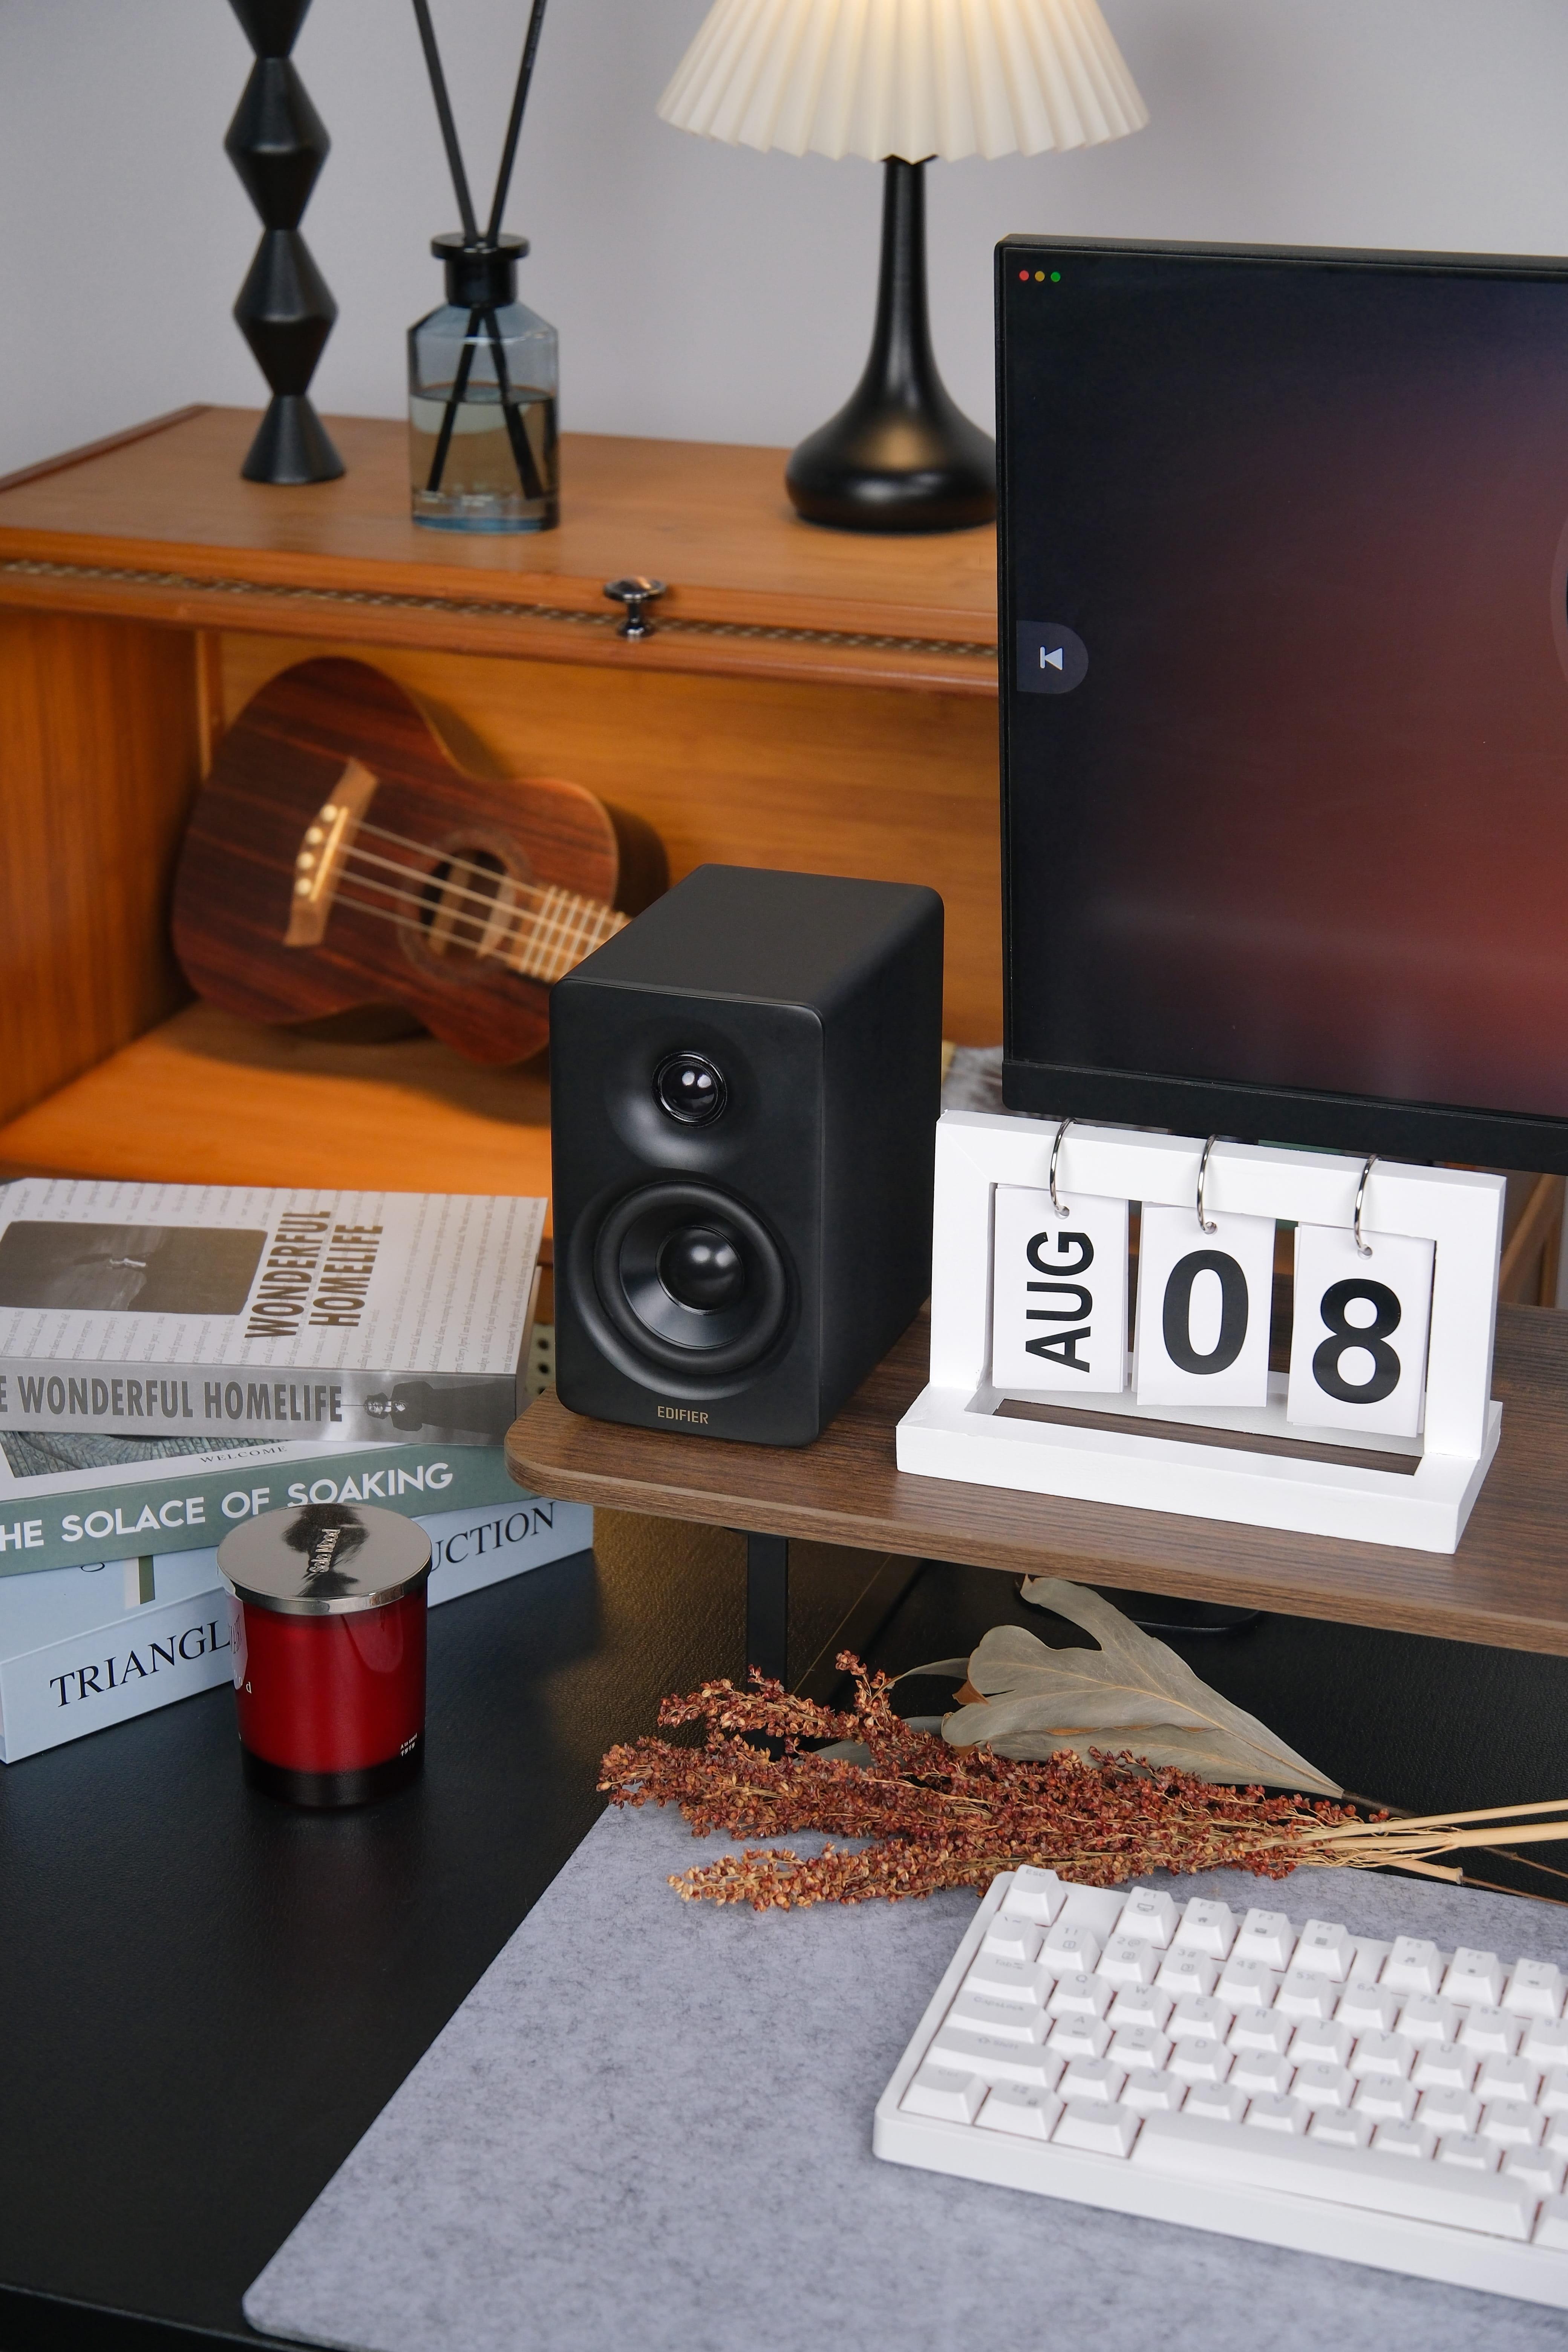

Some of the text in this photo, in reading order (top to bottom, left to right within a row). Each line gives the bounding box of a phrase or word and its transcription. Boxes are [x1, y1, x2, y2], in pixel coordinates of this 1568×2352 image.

[245, 1211, 331, 1338] WONDERFUL
[308, 1225, 383, 1327] HOMELIFE
[1025, 1231, 1094, 1372] AUG
[1162, 1249, 1249, 1375] 0
[1312, 1278, 1402, 1404] 8
[17, 1376, 193, 1418] WONDERFUL
[204, 1381, 342, 1422] HOMELIFE
[657, 1405, 709, 1424] EDIFIER
[200, 1446, 288, 1464] WELCOME
[0, 1462, 453, 1551] HE SOLACE OF SOAKING
[49, 1620, 230, 1707] TRIANGL
[1026, 1868, 1046, 1877] Esc
